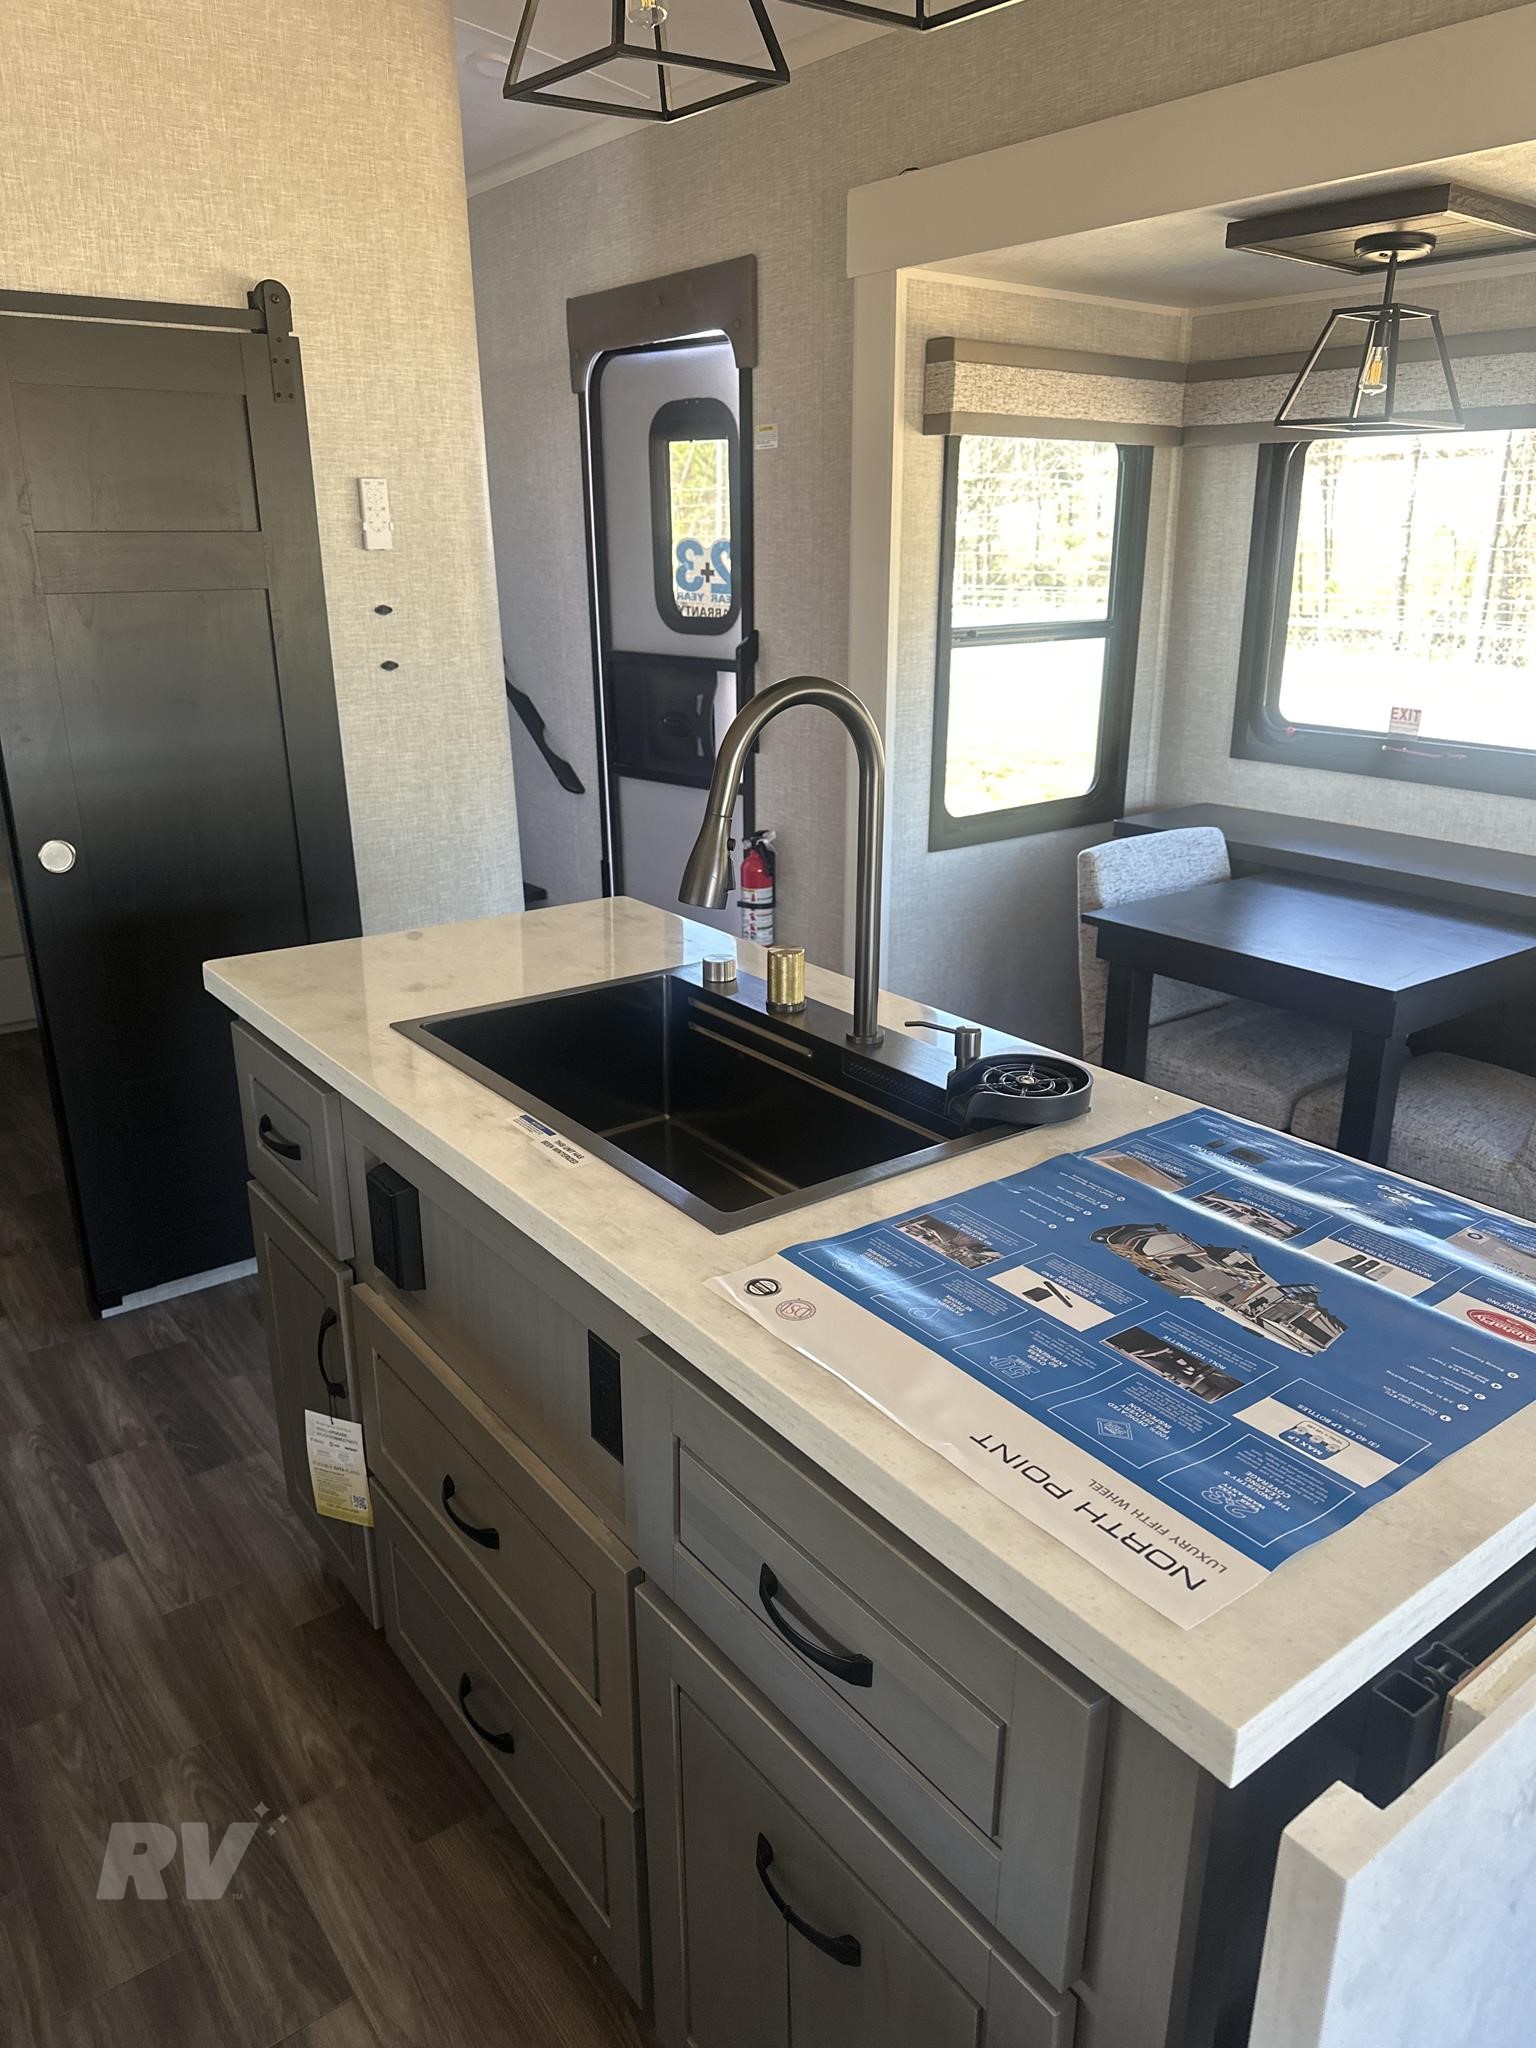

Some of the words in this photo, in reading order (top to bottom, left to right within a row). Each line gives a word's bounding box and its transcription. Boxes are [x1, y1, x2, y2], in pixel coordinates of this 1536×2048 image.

[1391, 707, 1422, 722] EXIT
[1483, 1297, 1522, 1313] ROOFING
[1470, 1313, 1536, 1342] AlphaPly
[1160, 1334, 1193, 1351] DINETTE
[1105, 1401, 1149, 1427] DEDICATED
[1127, 1402, 1173, 1429] INSPECTION
[1294, 1403, 1333, 1423] BOTTLES
[1285, 1434, 1300, 1442] LP
[1298, 1441, 1324, 1455] MAX
[1354, 1434, 1369, 1442] 40
[1366, 1440, 1381, 1448] (3)
[967, 1429, 1074, 1499] POINT
[1082, 1477, 1133, 1510] WHEEL
[1221, 1469, 1274, 1501] INDUSTRY'S
[1243, 1470, 1292, 1499] COVERAGE
[1243, 1476, 1281, 1499] LEADING
[1272, 1499, 1291, 1511] THE
[1129, 1508, 1170, 1535] FIFTH
[1072, 1500, 1207, 1591] NORTH
[1167, 1533, 1228, 1573] LUXURY
